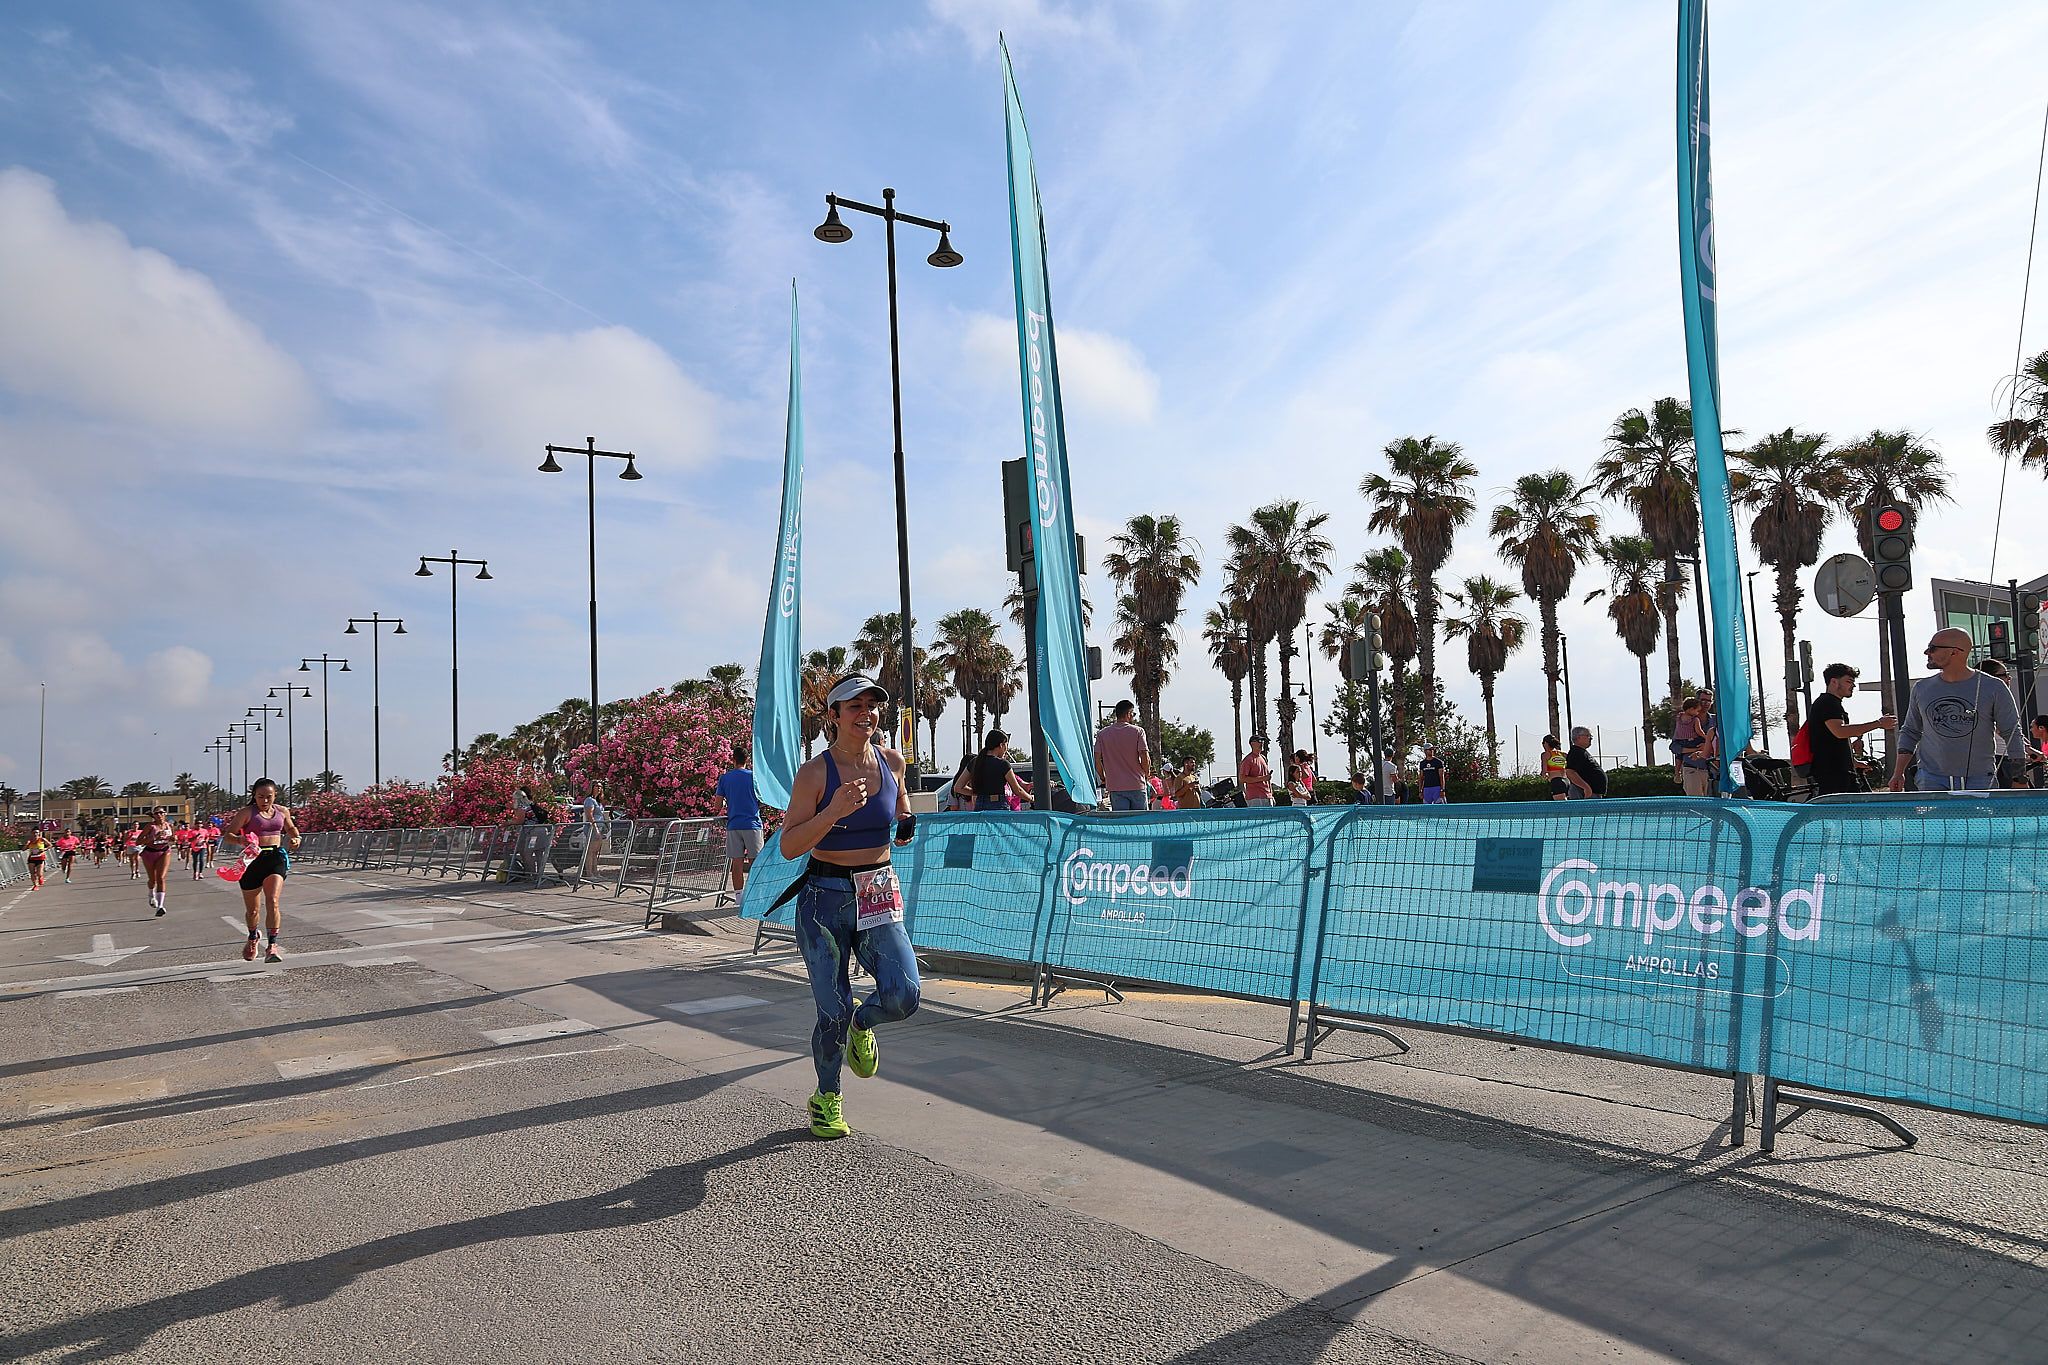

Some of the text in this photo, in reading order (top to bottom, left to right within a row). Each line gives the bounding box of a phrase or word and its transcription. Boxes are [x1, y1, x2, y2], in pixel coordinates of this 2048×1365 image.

[1062, 847, 1195, 905] Compeed
[1101, 909, 1146, 923] AMPOLLAS
[1538, 858, 1826, 946] Compeed
[1625, 954, 1719, 980] AMPOLLAS
